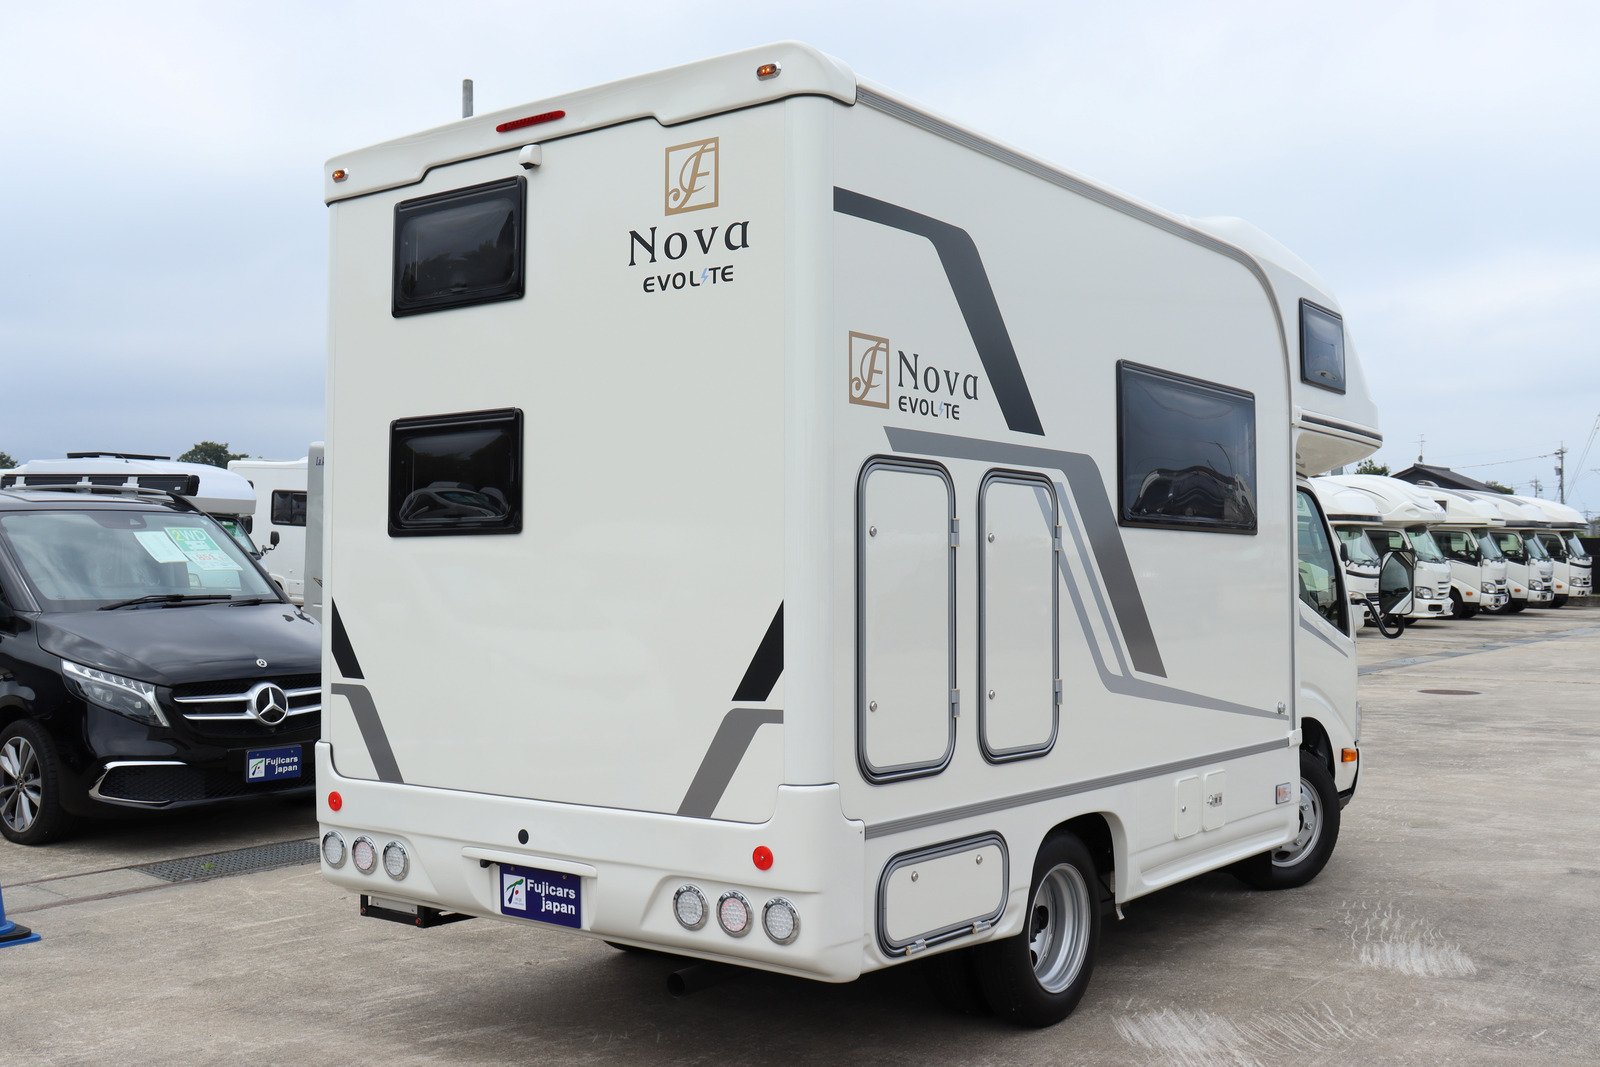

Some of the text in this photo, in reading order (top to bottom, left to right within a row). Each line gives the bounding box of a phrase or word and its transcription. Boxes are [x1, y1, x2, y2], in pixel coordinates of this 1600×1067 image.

[629, 221, 750, 267] Nova
[898, 350, 979, 401] Nova
[171, 529, 207, 541] 2WD
[265, 756, 299, 766] Fujicars
[274, 764, 298, 775] japan
[526, 879, 576, 899] Fujicars
[541, 896, 576, 915] japan
